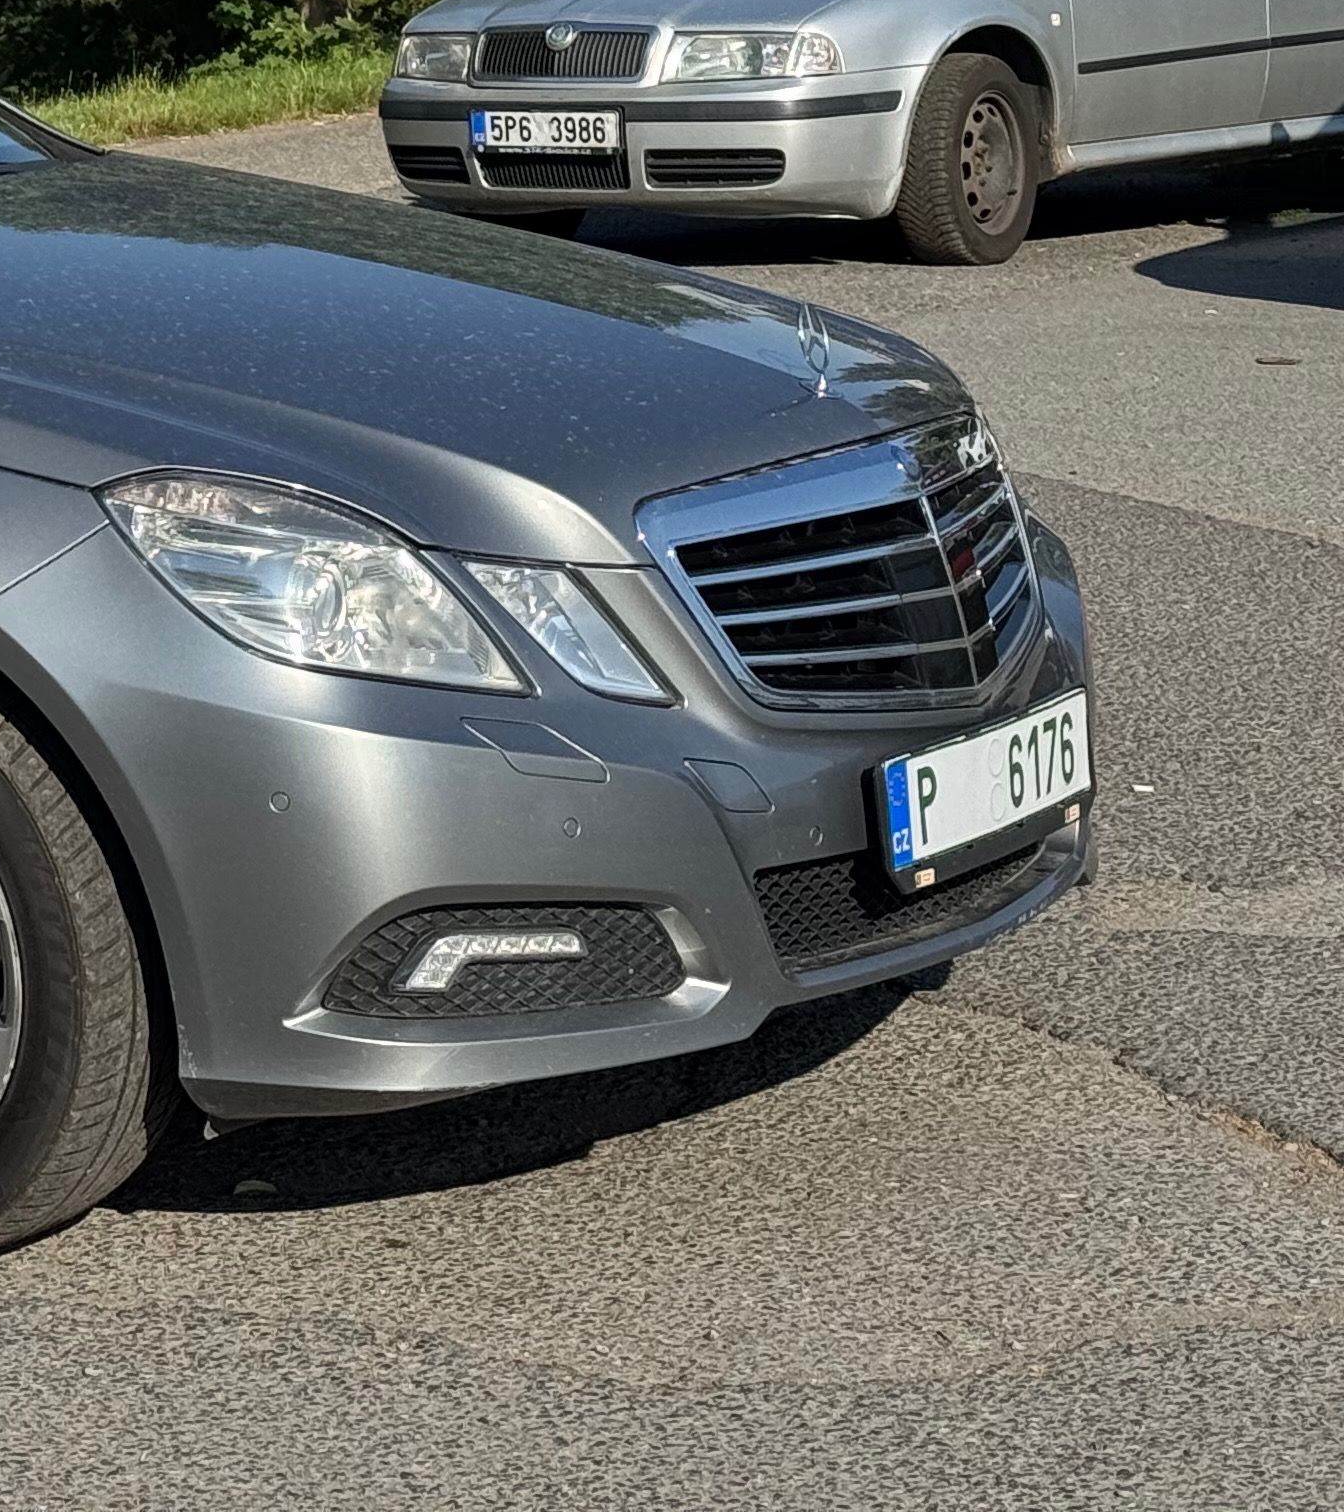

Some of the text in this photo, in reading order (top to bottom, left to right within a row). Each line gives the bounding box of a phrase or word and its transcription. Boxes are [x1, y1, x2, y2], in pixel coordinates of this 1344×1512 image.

[490, 116, 606, 144] 5P6 3986
[917, 711, 1075, 846] P 6176
[892, 828, 910, 854] CZ
